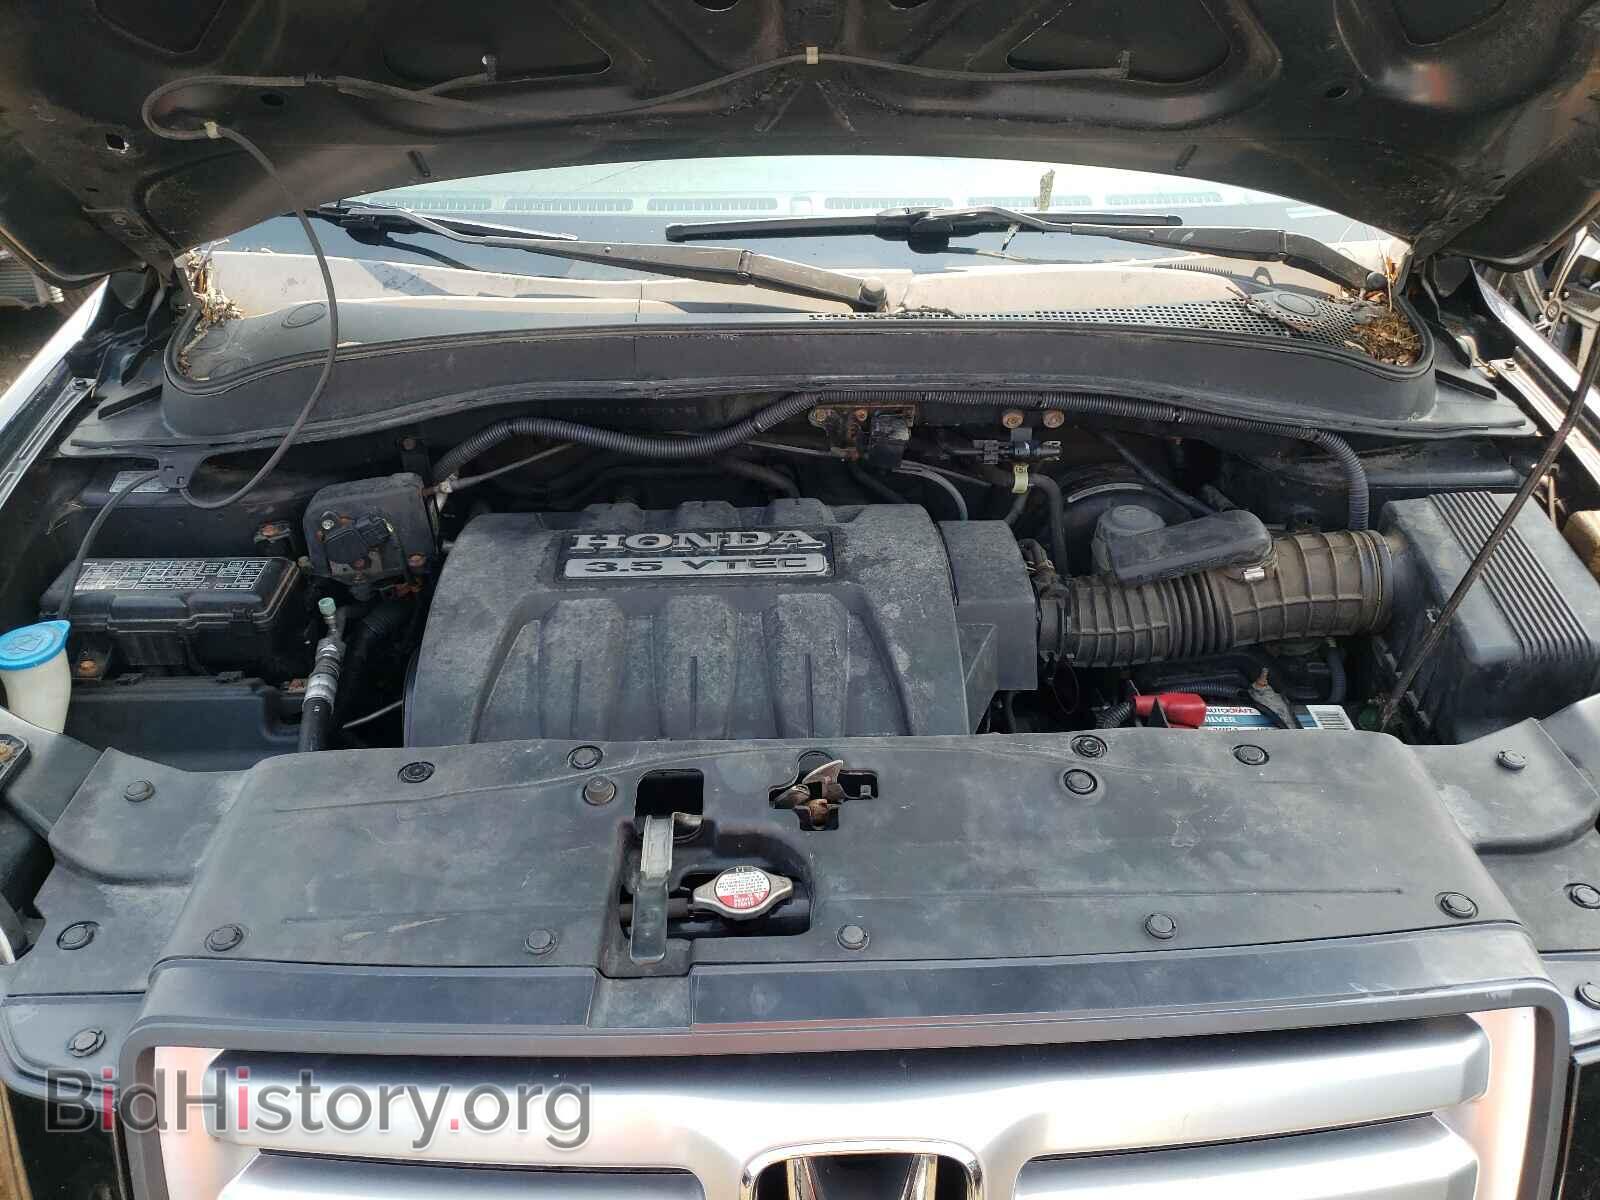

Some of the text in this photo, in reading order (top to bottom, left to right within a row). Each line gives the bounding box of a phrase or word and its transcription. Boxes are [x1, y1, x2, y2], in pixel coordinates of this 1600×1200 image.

[570, 530, 826, 551] HONDA
[584, 557, 808, 573] 3.5 VTEC
